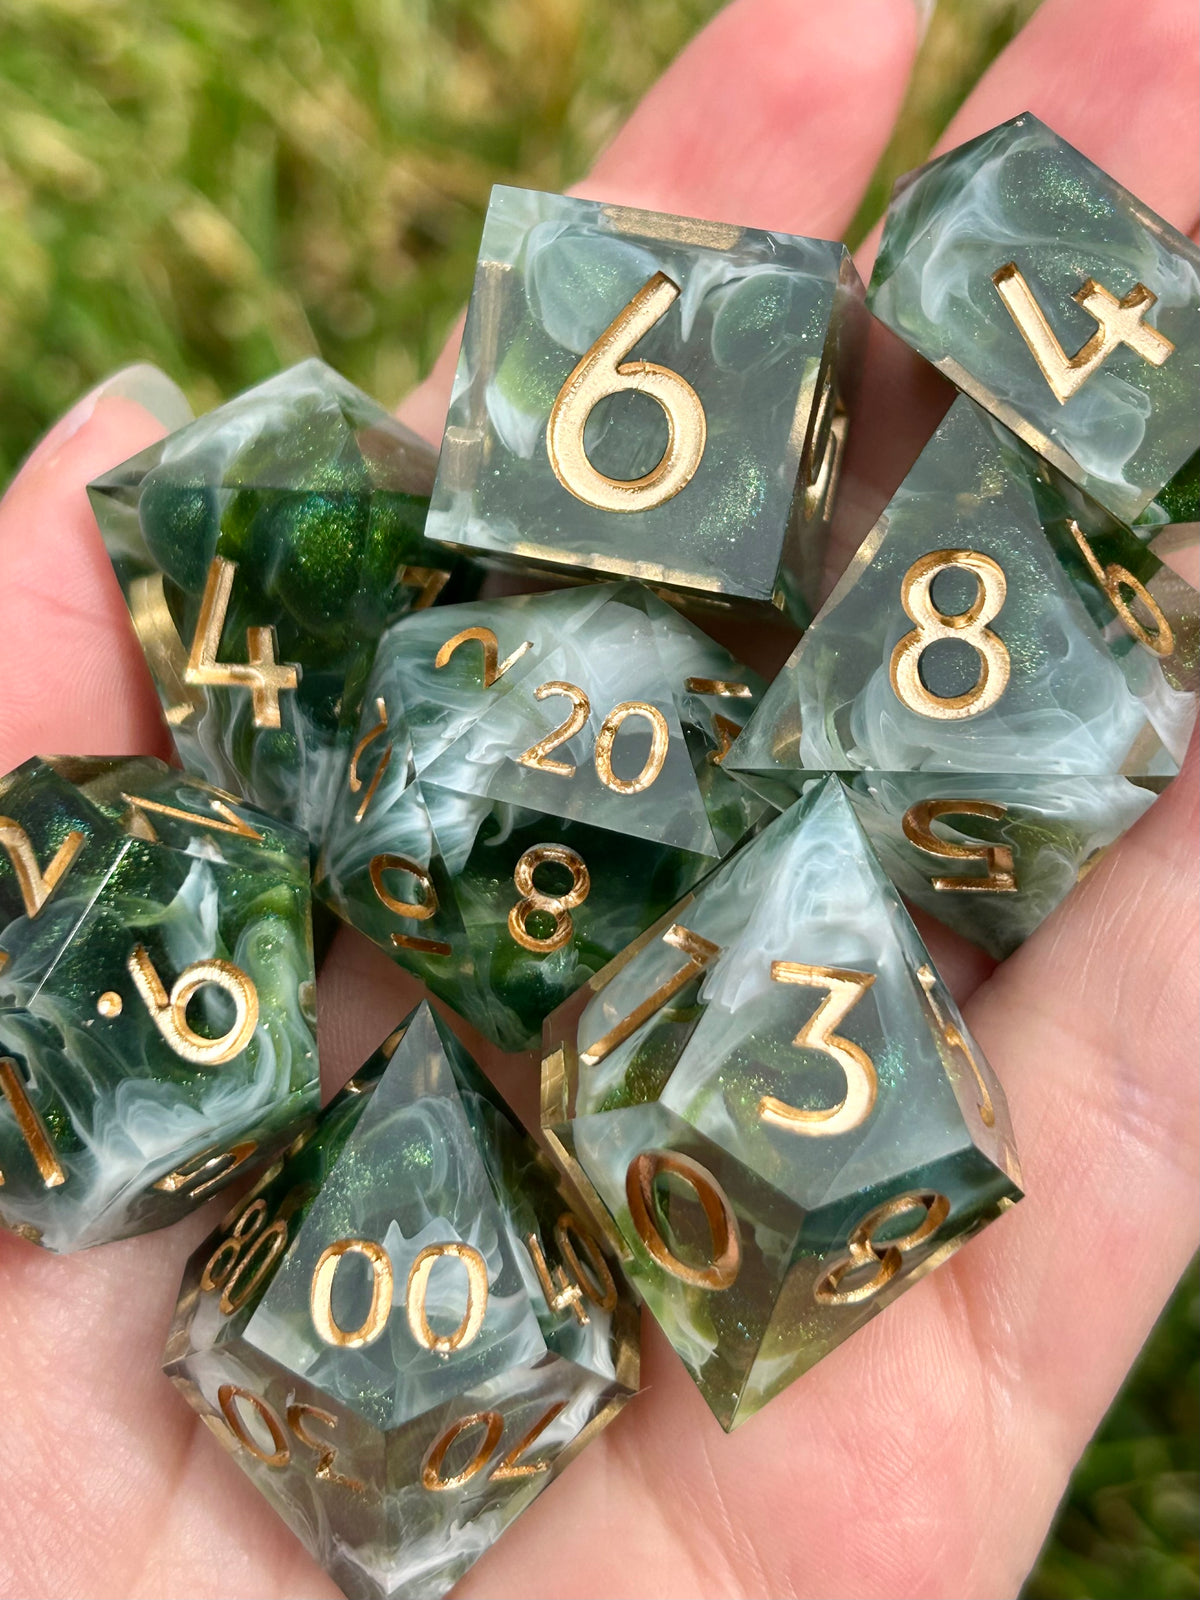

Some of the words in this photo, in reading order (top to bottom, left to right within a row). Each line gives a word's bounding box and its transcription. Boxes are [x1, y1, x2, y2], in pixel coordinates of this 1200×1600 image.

[547, 270, 707, 513] 6
[991, 262, 1175, 405] 4
[186, 555, 302, 729] 4
[889, 548, 1011, 720] 8
[1066, 518, 1174, 657] 6
[517, 680, 669, 795] 20
[508, 843, 590, 952] 8
[580, 924, 722, 1066] 7
[757, 960, 878, 1137] 3
[201, 1198, 288, 1316] 80
[528, 1211, 617, 1326] 40
[626, 1149, 742, 1290] 0
[814, 1188, 950, 1305] 8
[310, 1238, 488, 1354] 00
